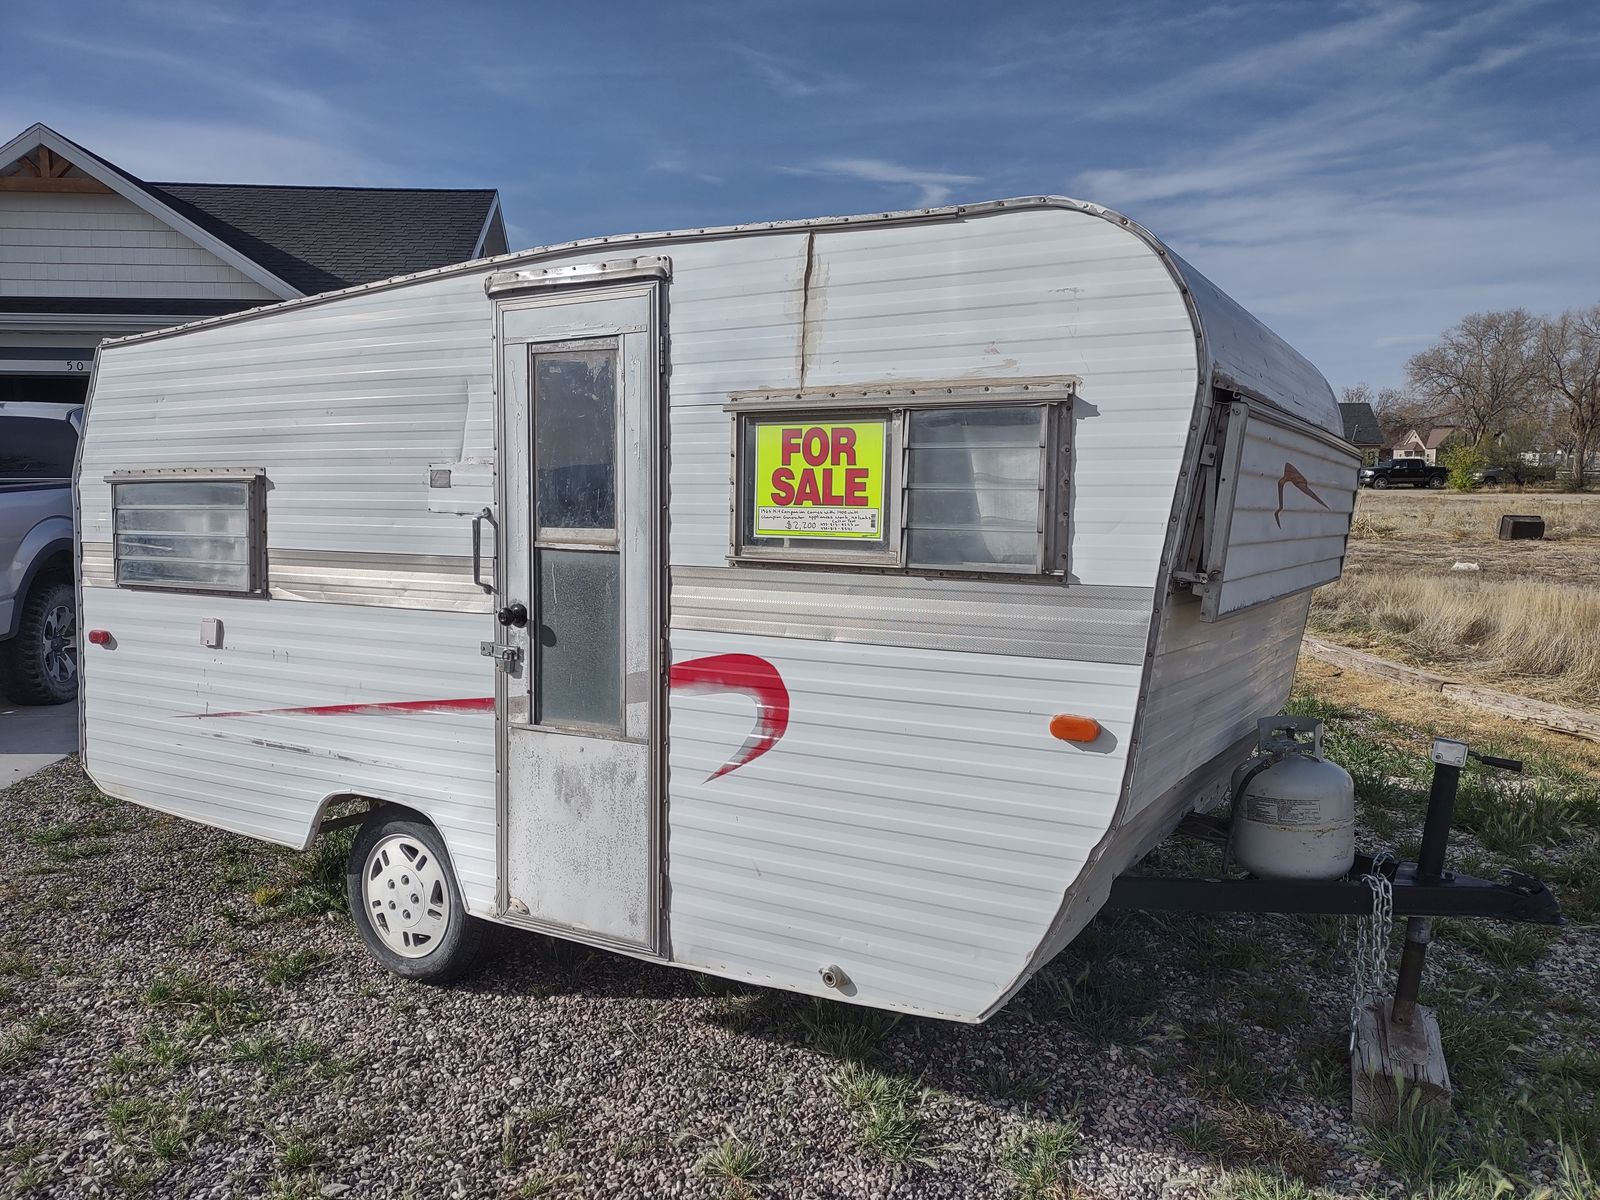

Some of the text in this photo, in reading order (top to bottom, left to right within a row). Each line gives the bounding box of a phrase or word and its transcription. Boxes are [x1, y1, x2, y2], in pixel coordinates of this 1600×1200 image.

[66, 360, 84, 371] 50
[782, 427, 857, 467] FOR
[770, 467, 869, 507] SALE
[784, 520, 816, 530] $2,200
